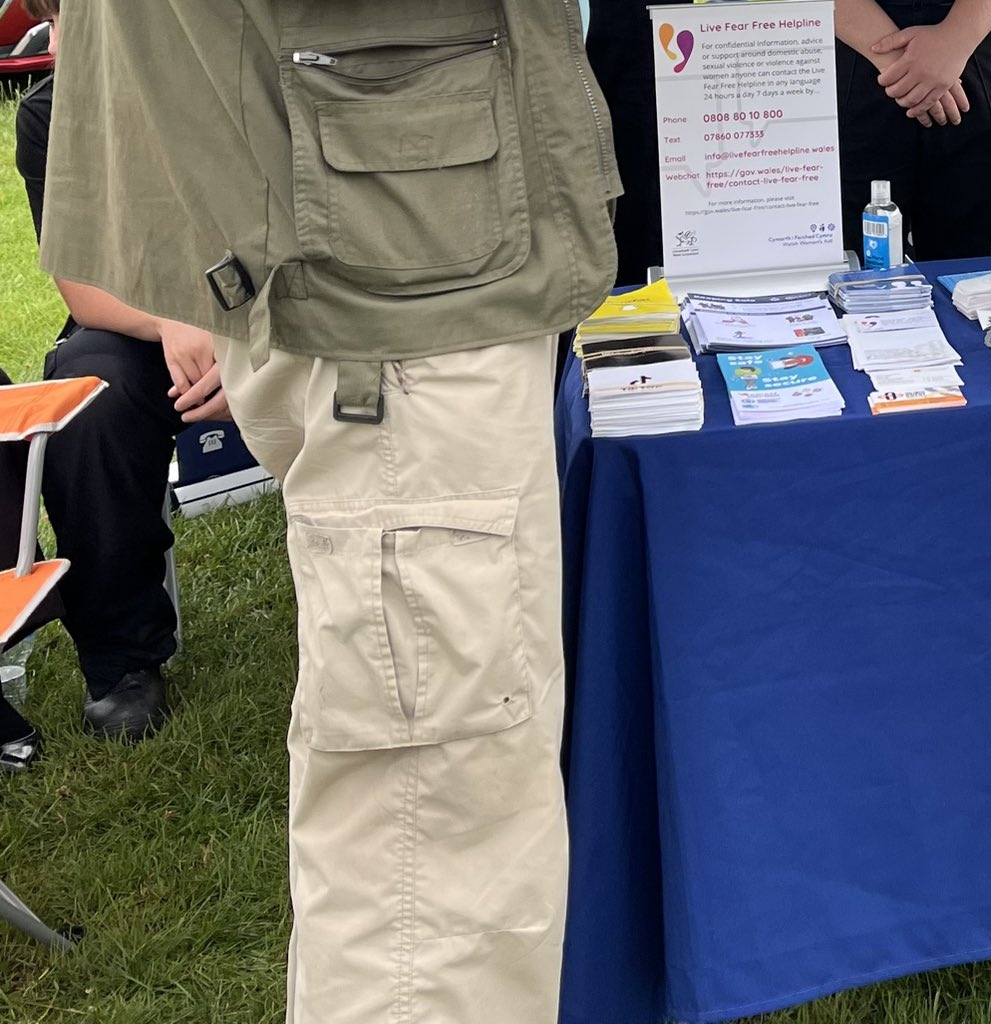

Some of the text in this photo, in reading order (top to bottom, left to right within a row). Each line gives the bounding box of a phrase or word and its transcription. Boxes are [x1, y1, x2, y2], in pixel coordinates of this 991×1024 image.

[700, 18, 821, 33] Live Fear Free Helpline
[715, 40, 755, 49] confidential
[801, 37, 823, 45] advice
[711, 52, 739, 61] support
[767, 48, 799, 56] domestic
[703, 62, 725, 70] sexual
[727, 61, 755, 69] violence
[795, 57, 820, 66] against
[731, 72, 756, 80] anyone
[737, 80, 766, 88] Helpline
[790, 77, 821, 86] language
[742, 91, 755, 99] day
[762, 90, 779, 98] days
[663, 116, 687, 124] Phone
[703, 109, 783, 123] 0808 80 10 800
[664, 136, 681, 144] Text
[703, 130, 765, 142] 07860 077333
[664, 155, 686, 163] Email
[705, 146, 835, 160] info@livefearfreehelpline.wales
[706, 175, 819, 189] free/contact-live-fear-free
[727, 354, 763, 362] Stay
[762, 374, 799, 383] Stay
[764, 376, 818, 388] secure
